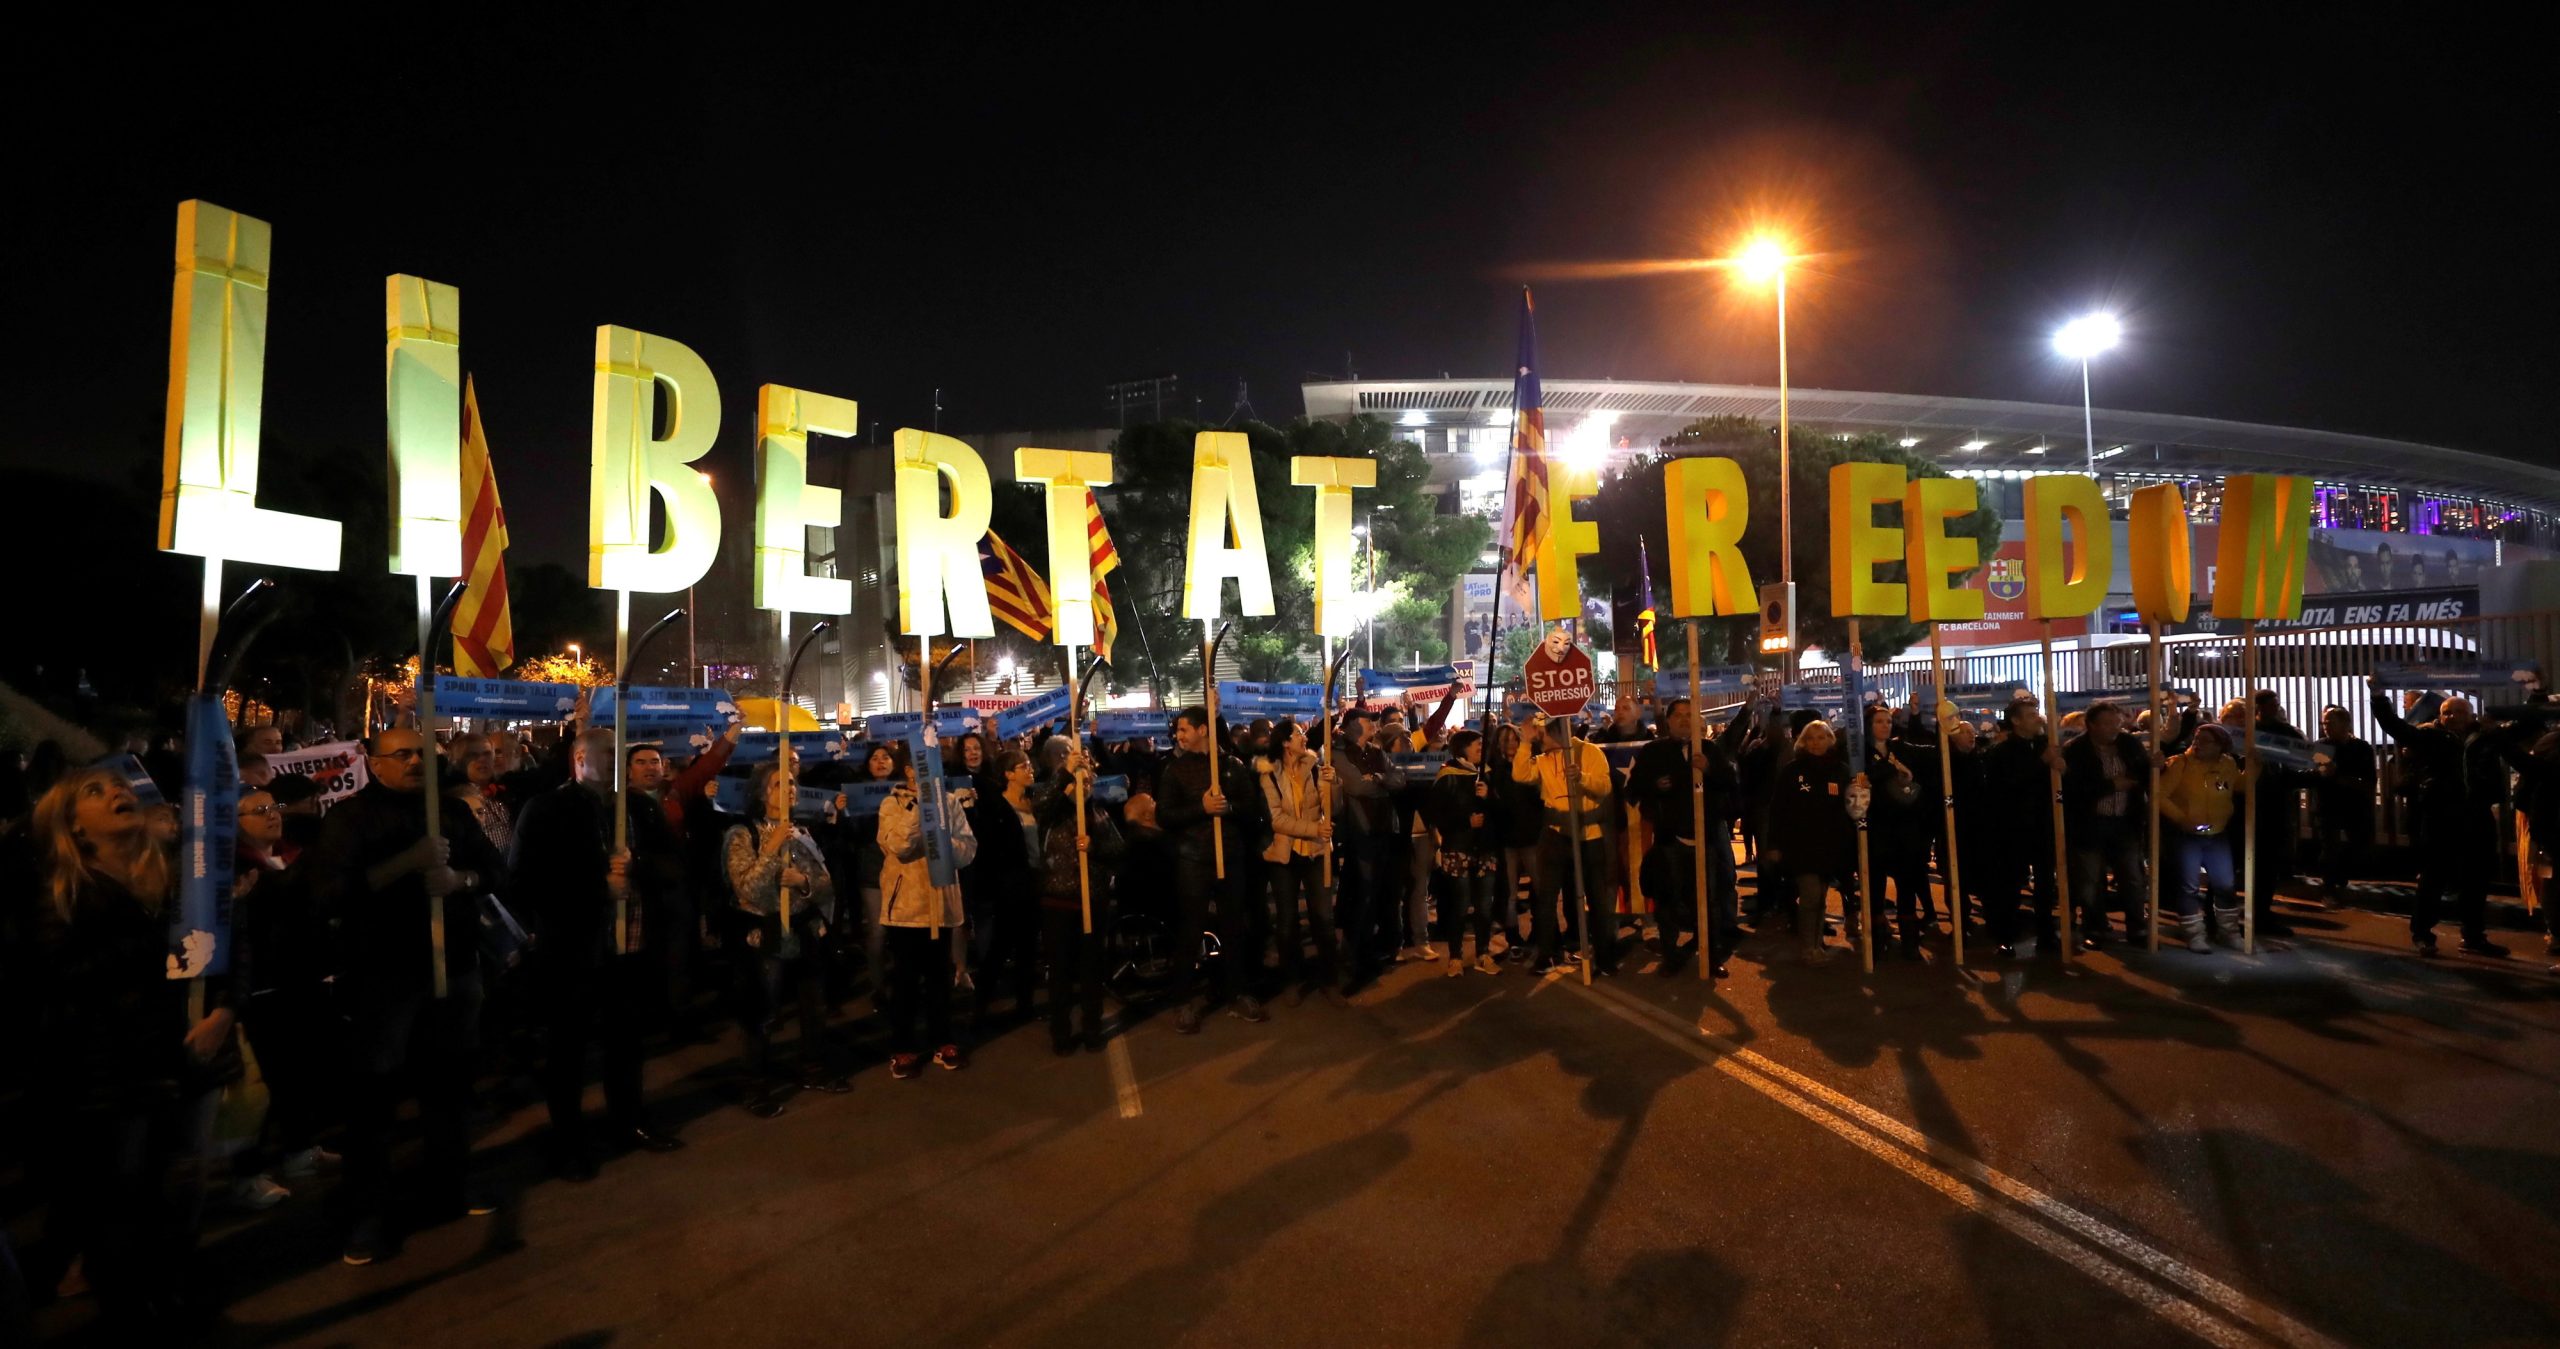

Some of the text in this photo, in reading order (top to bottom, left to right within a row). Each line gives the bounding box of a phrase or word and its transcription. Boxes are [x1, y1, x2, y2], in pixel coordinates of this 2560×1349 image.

[157, 198, 2313, 646] LIBERTAT FREEDOM
[1984, 611, 2024, 620] TAINMENT
[2344, 606, 2382, 625] ENS
[2387, 603, 2411, 622] FA
[2416, 597, 2464, 620] MÉS
[1938, 622, 2000, 631] FC BARCELONA
[1532, 668, 1588, 689] STOP
[1534, 684, 1591, 703] REPRESSIÓ
